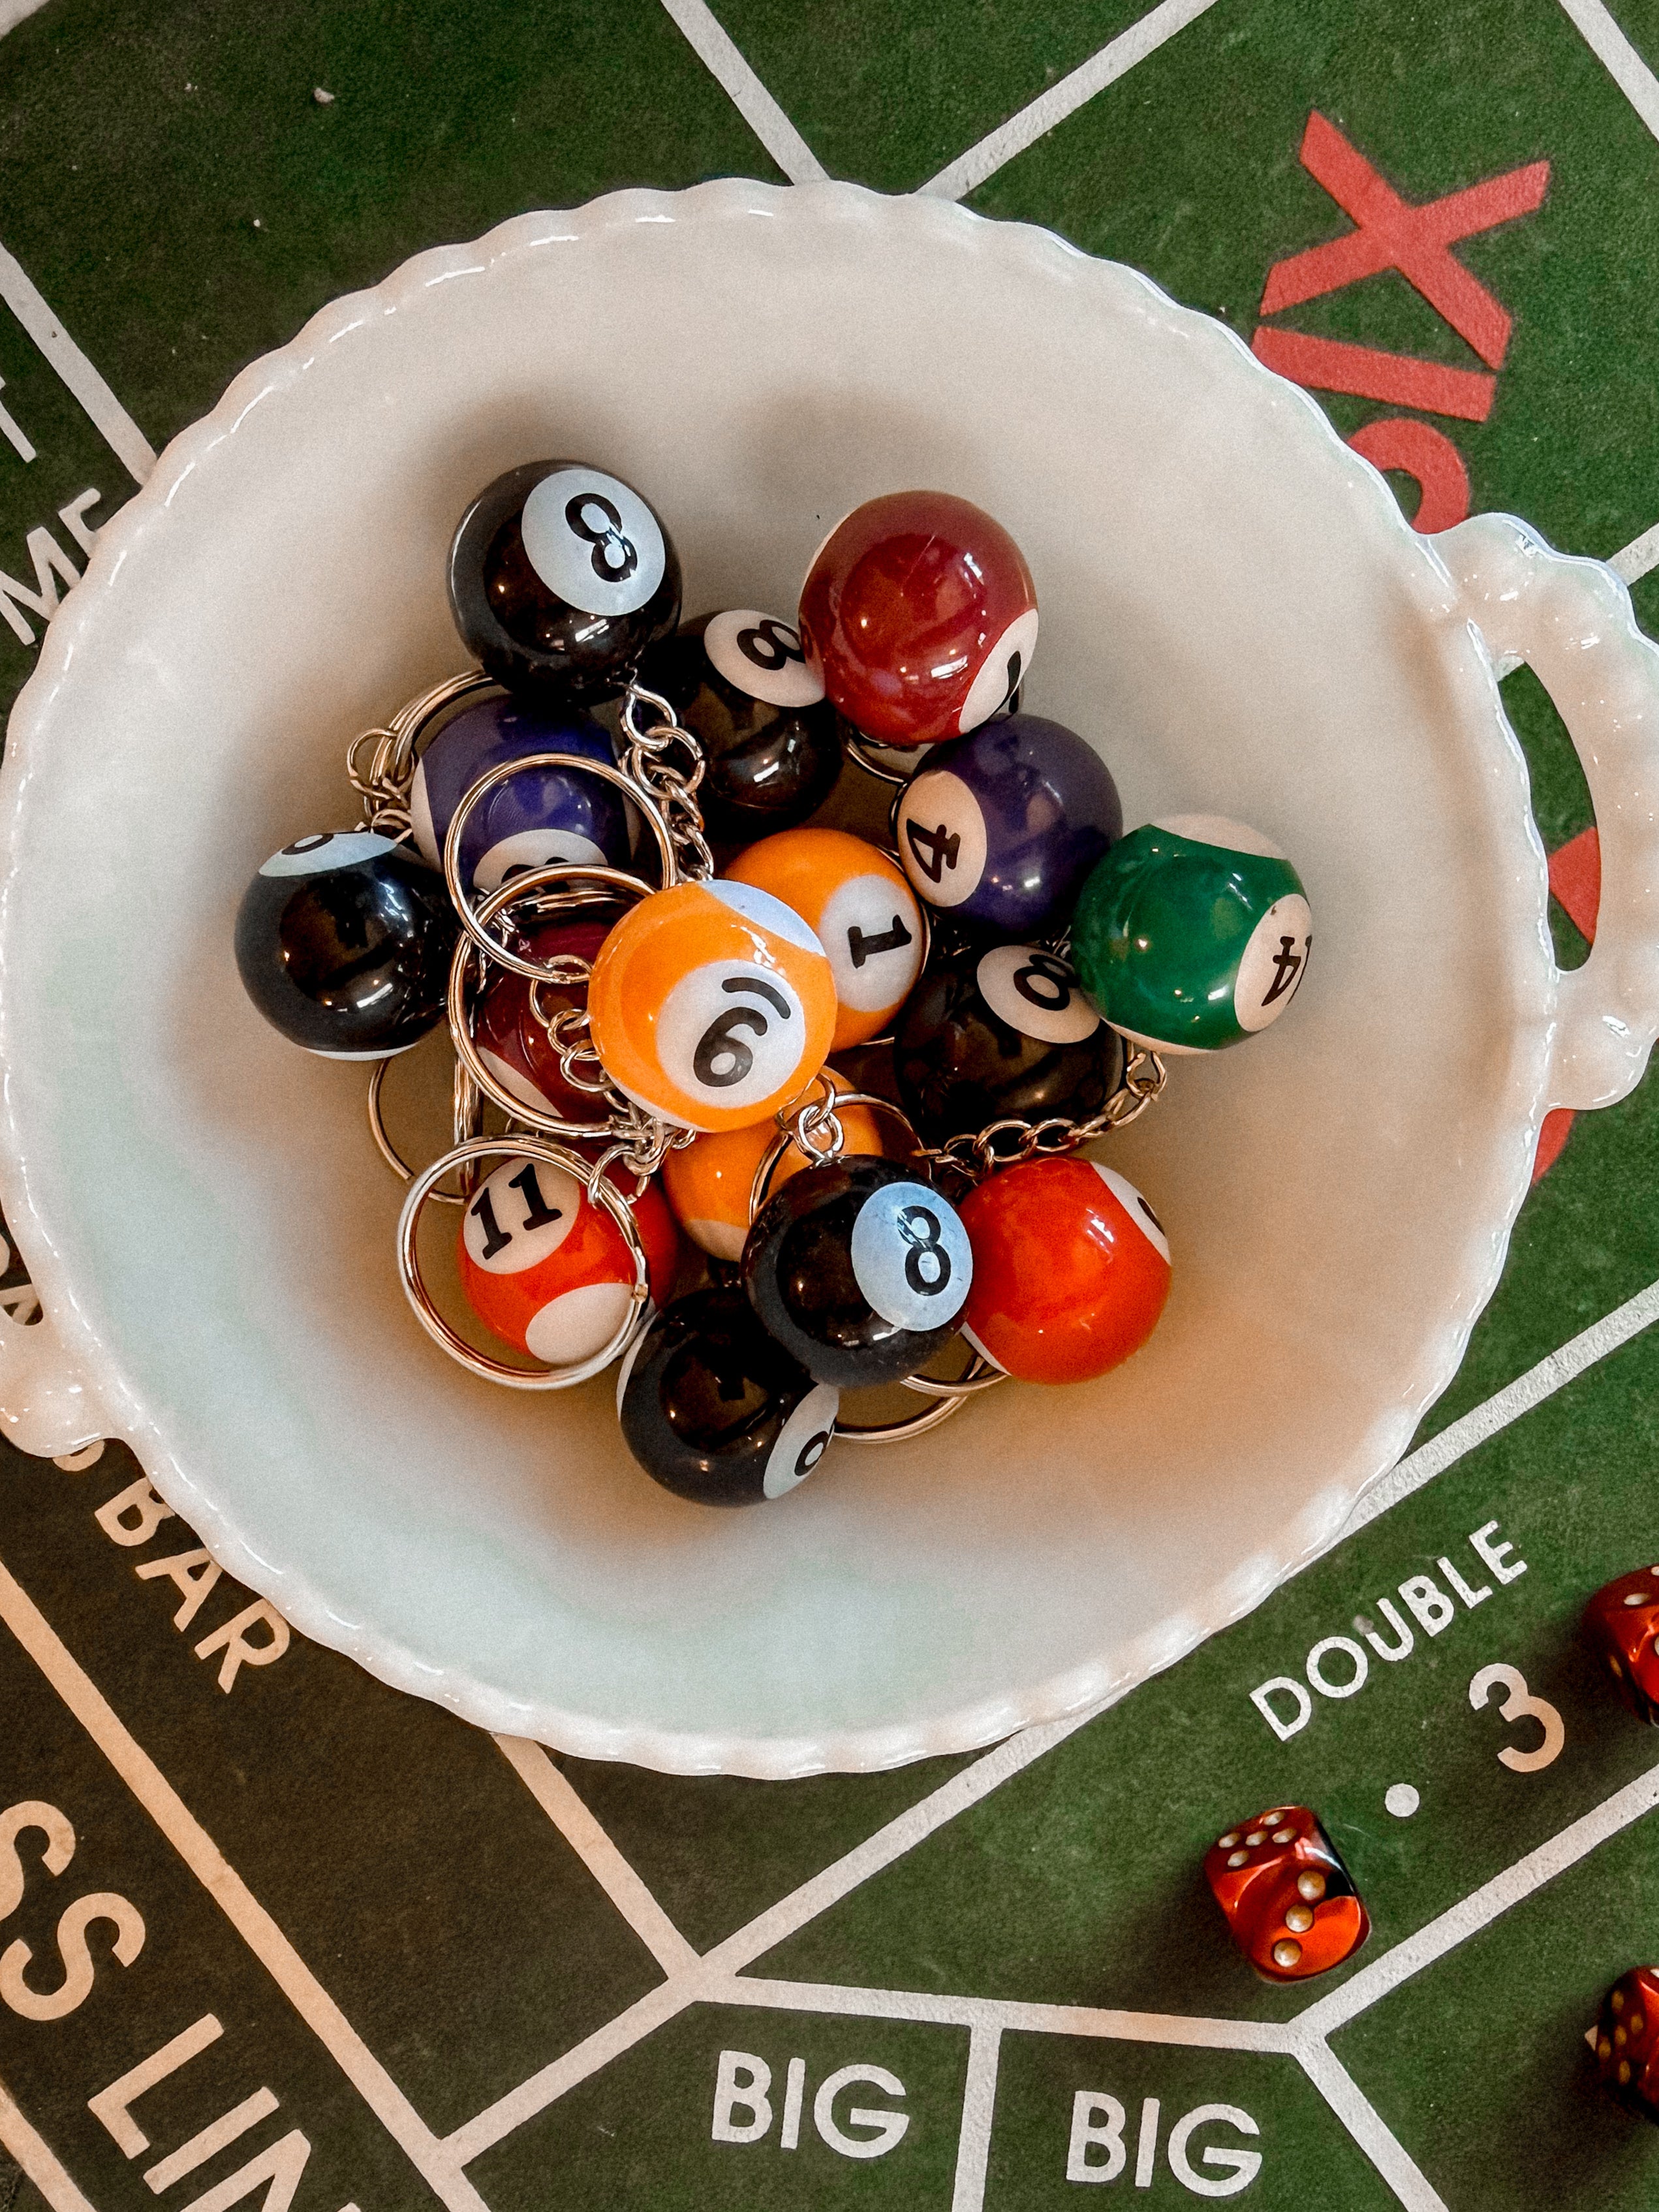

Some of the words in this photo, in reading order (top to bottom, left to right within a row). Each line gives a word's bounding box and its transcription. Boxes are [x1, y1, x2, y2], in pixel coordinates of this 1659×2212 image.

[565, 492, 638, 583] 8
[737, 619, 806, 671] 8
[906, 817, 961, 883] 4
[846, 914, 912, 969] 1
[1013, 954, 1081, 1011] 8
[471, 1163, 563, 1260] 11
[896, 1205, 952, 1296] 8
[94, 1476, 290, 1694] BAR
[1249, 1519, 1528, 1741] DOUBLE
[1468, 1662, 1565, 1773] 3
[711, 2049, 910, 2159] BIG
[1066, 2090, 1263, 2198] BIG
